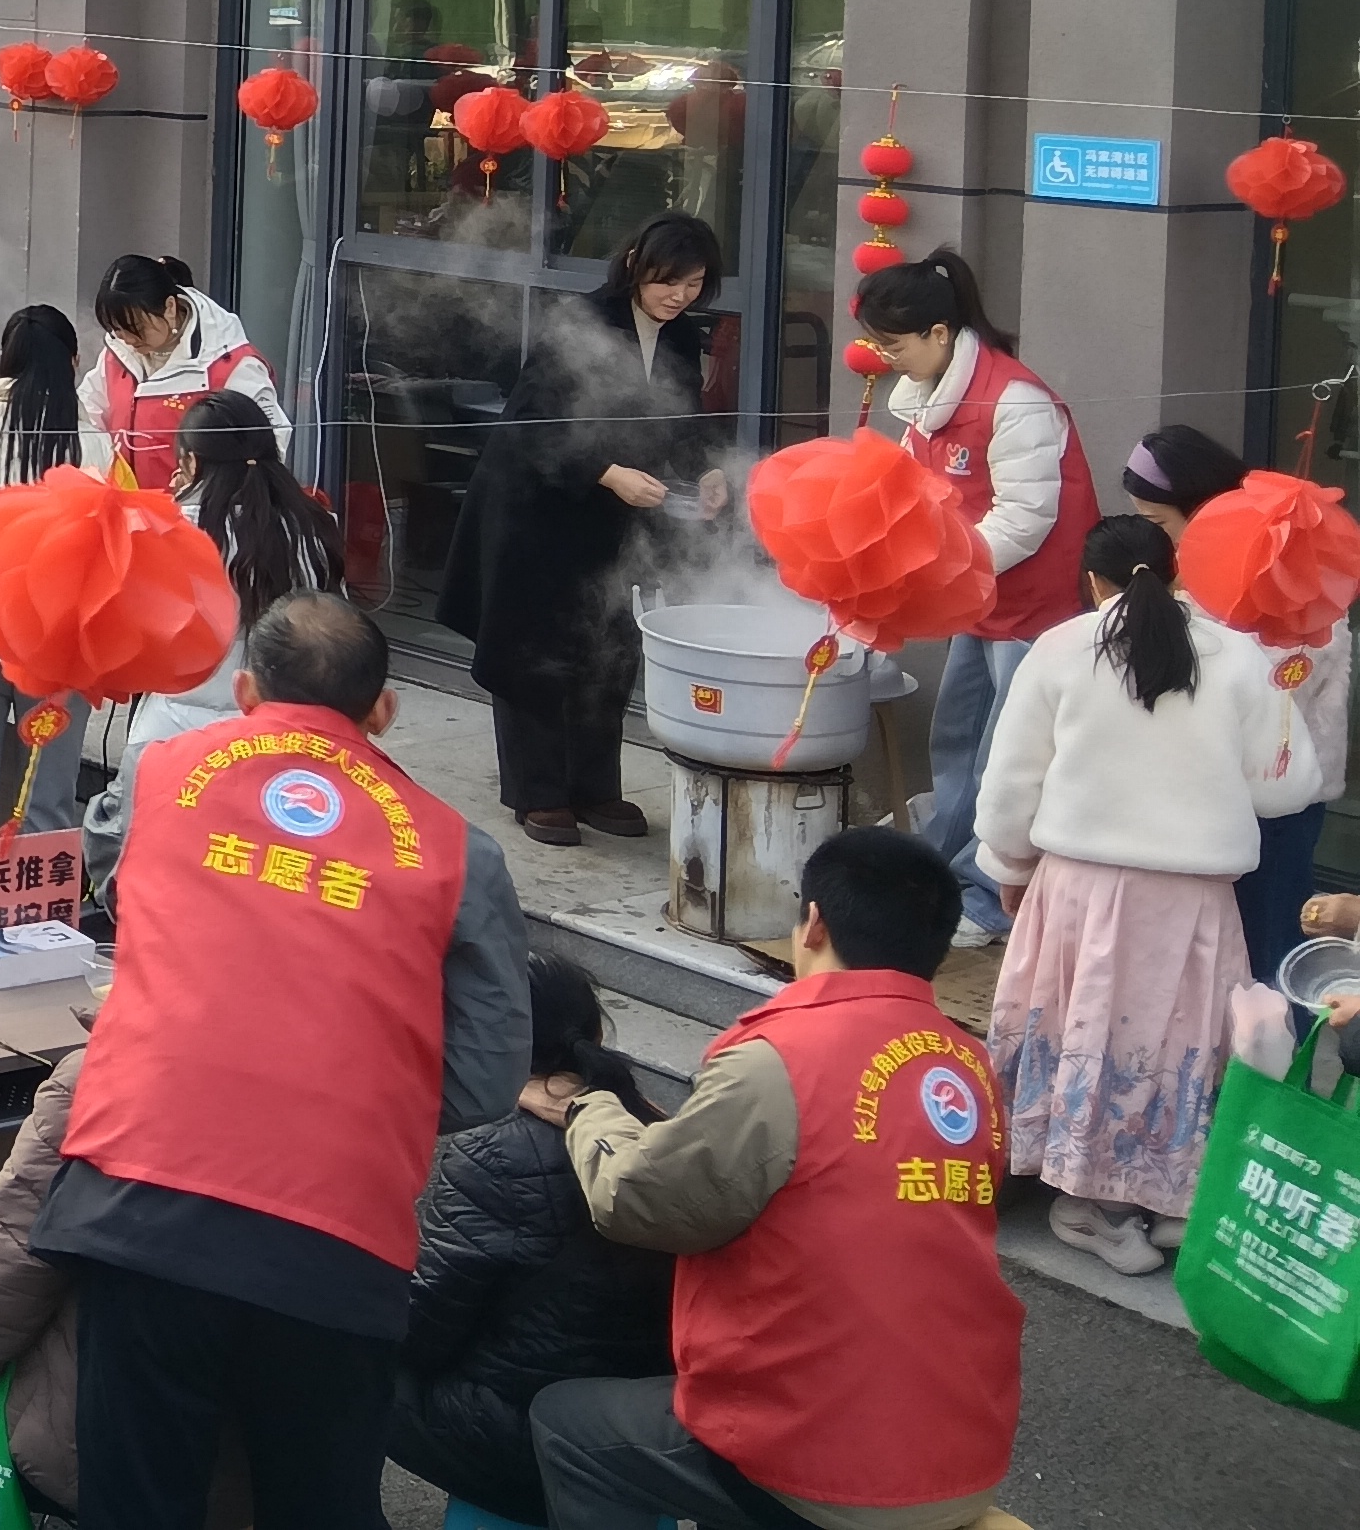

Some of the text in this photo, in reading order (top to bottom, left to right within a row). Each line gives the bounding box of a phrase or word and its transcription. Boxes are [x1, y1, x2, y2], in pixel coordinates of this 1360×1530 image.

[202, 831, 374, 910] 志愿者
[896, 1156, 994, 1205] 志愿者
